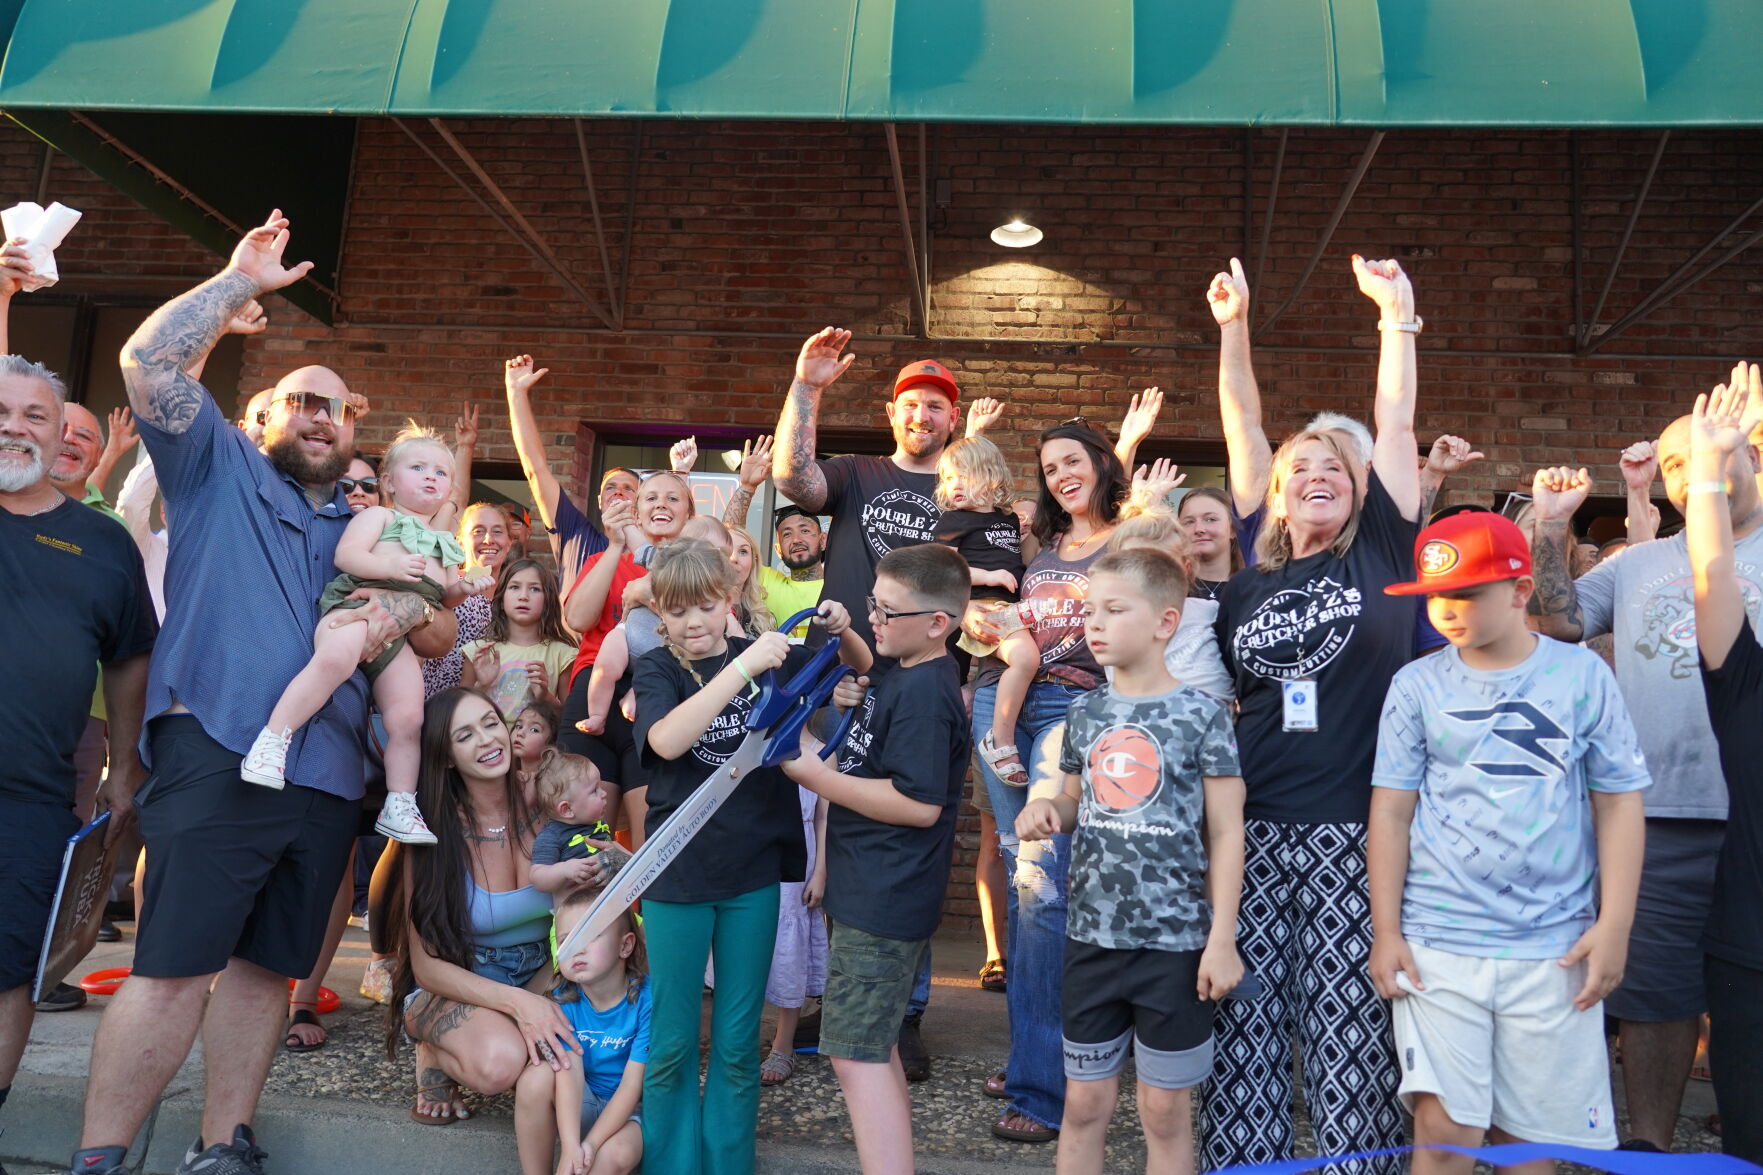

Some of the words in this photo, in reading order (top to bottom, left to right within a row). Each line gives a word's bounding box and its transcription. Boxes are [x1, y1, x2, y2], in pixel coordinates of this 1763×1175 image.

[881, 490, 908, 502] FAMILY
[911, 495, 936, 513] OWNED
[861, 503, 926, 530] DOUBLE
[869, 517, 919, 541] BUTCHER
[1026, 573, 1057, 590] FAMILY
[1318, 603, 1362, 623] SHOP
[1253, 661, 1300, 678] CUSTOM
[699, 750, 727, 763] CUSTOM
[1080, 808, 1178, 840] Champion
[625, 866, 657, 903] GOLDEN
[655, 840, 682, 870] VALLEY
[681, 815, 701, 840] AUTO
[700, 795, 719, 819] BODY
[657, 831, 681, 858] Donated
[1064, 1046, 1123, 1069] mpion
